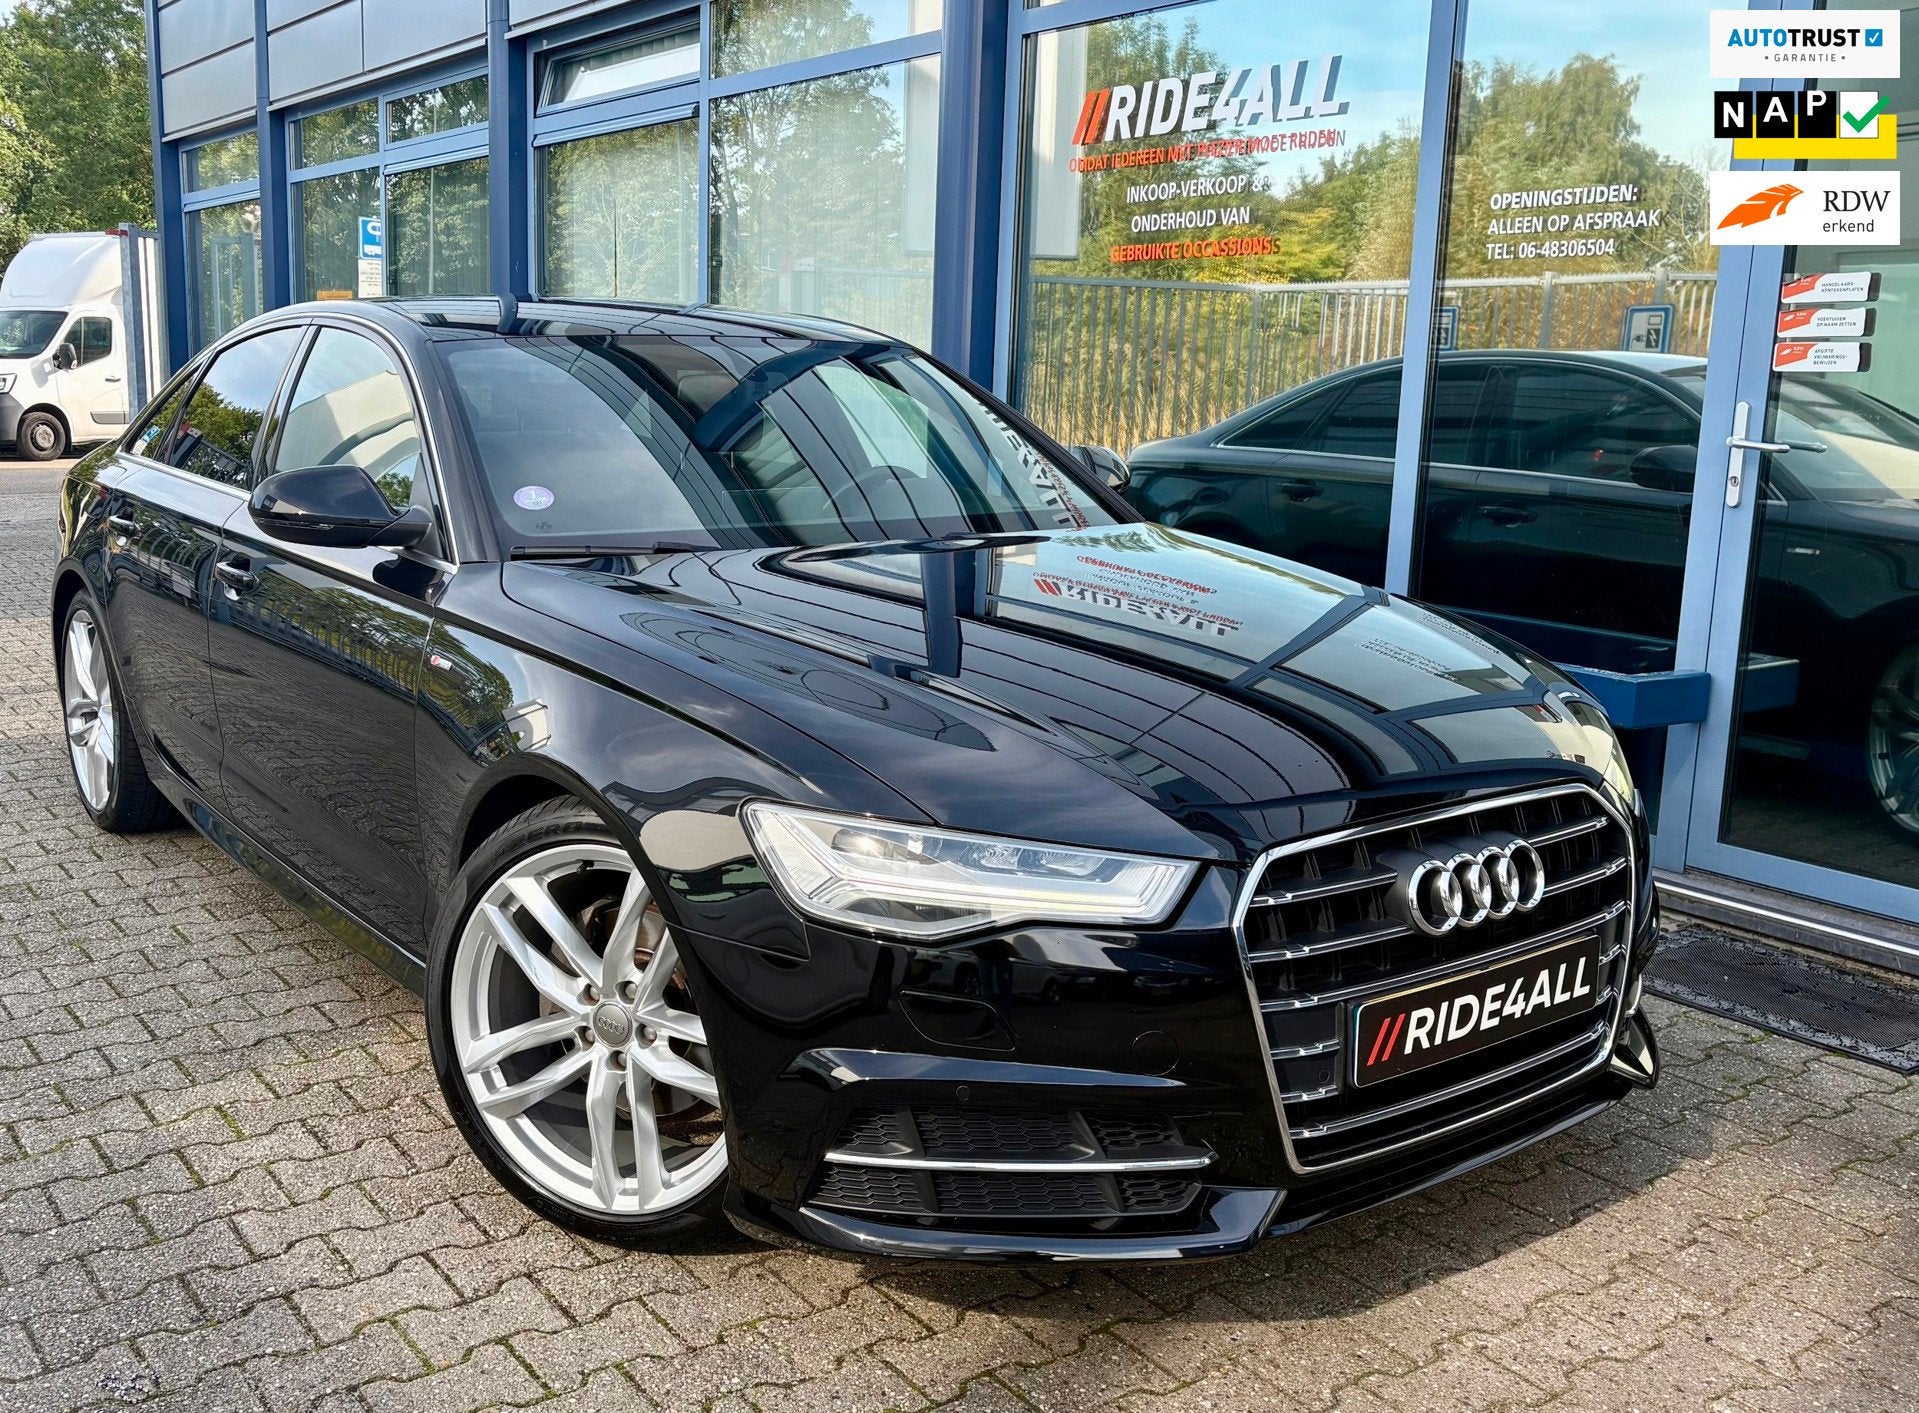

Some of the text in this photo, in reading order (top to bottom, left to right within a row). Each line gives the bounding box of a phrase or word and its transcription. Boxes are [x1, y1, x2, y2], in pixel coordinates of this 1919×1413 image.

[1127, 174, 1263, 204] INKOOP-VERKOOP &
[1490, 184, 1639, 211] OPENINGSTIJDEN:
[1131, 206, 1251, 233] ONDERHOUD VAN
[1487, 209, 1662, 235] ALLEEN OP AFSPRAAK
[1111, 236, 1273, 263] GEBRUIKTE OCCASSIONS
[1486, 238, 1615, 260] TEL: 06-48306504
